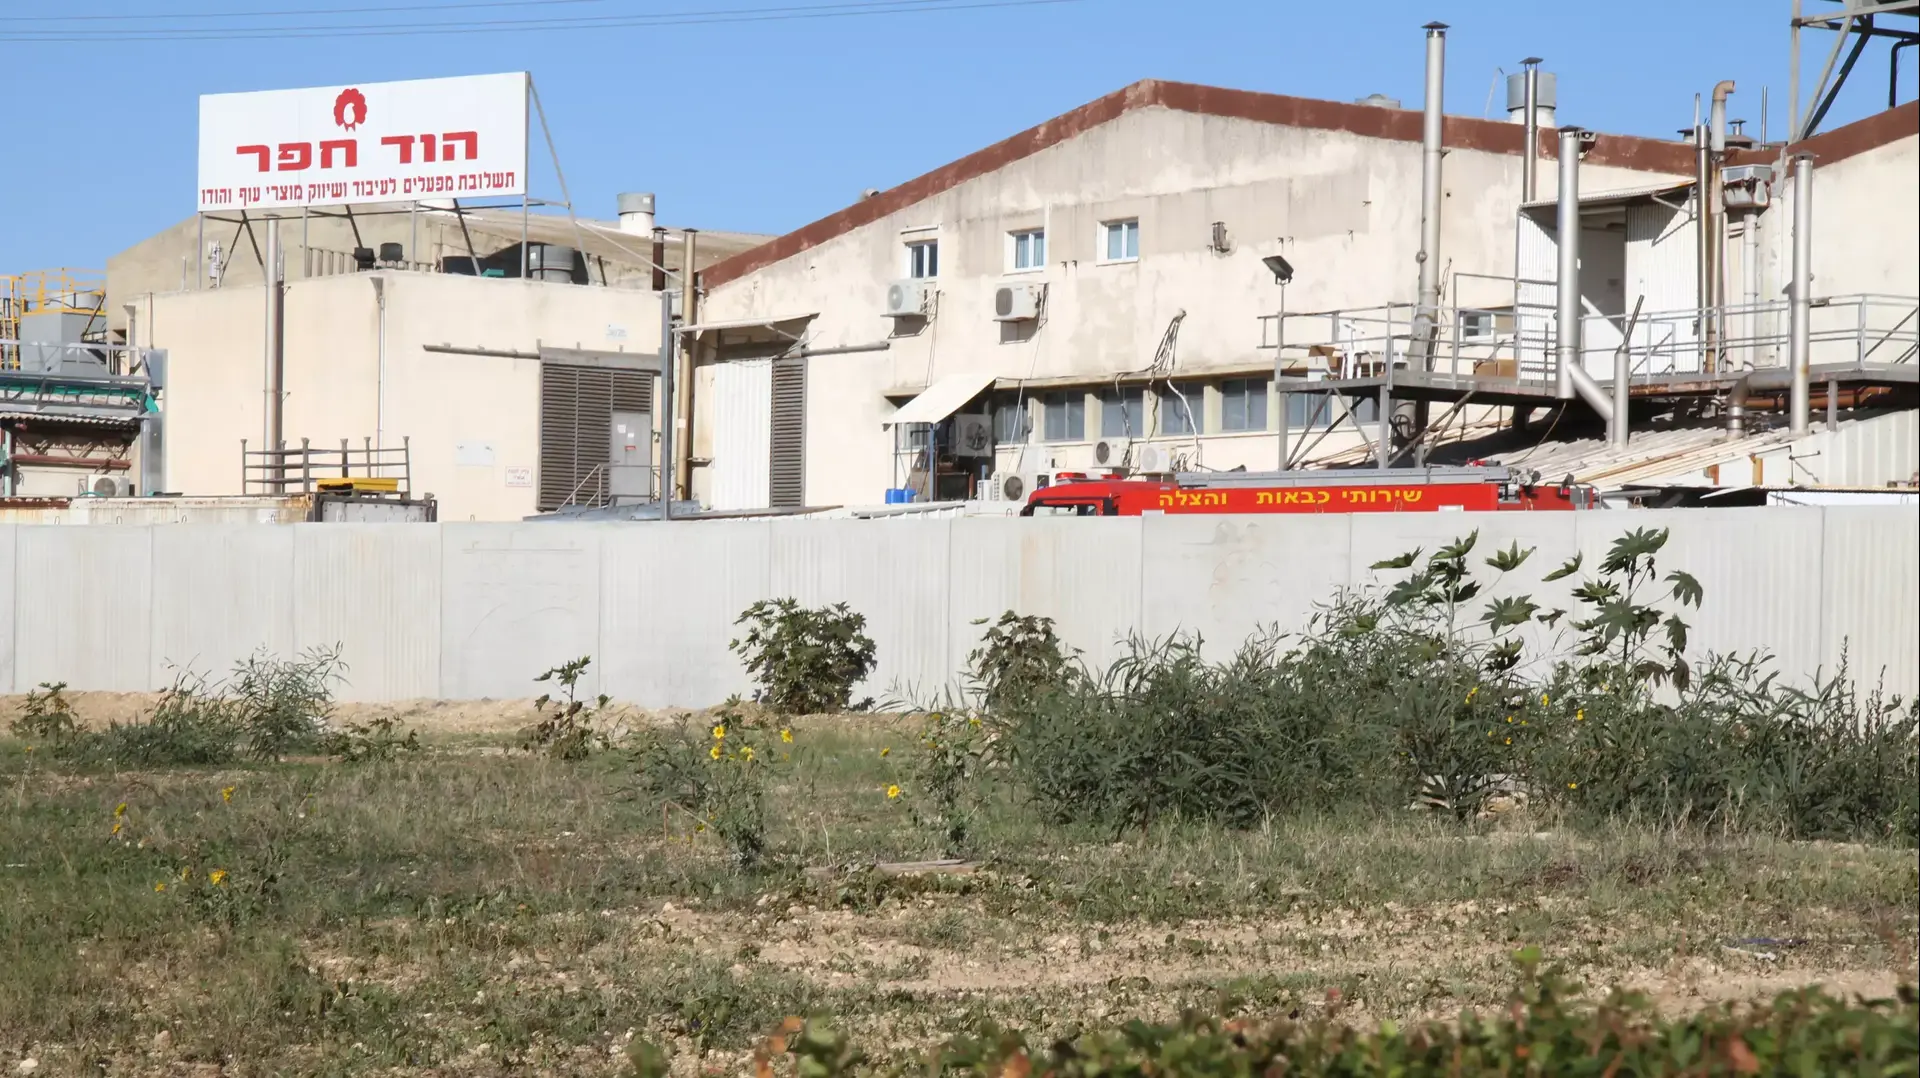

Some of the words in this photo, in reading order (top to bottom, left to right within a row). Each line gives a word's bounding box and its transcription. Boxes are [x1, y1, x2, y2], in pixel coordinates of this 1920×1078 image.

[236, 139, 358, 173] חפר
[381, 130, 478, 164] הוד
[352, 177, 397, 196] לעיבוד
[403, 175, 454, 194] מפעלים
[458, 171, 515, 190] תשלובת
[201, 188, 232, 204] והודו
[239, 186, 260, 206] עוף
[265, 184, 303, 200] מוצרי
[308, 182, 348, 203] ושיווק
[1159, 490, 1227, 506] והצלה
[1256, 491, 1330, 505] כבאות
[1342, 490, 1422, 503] שירותי
